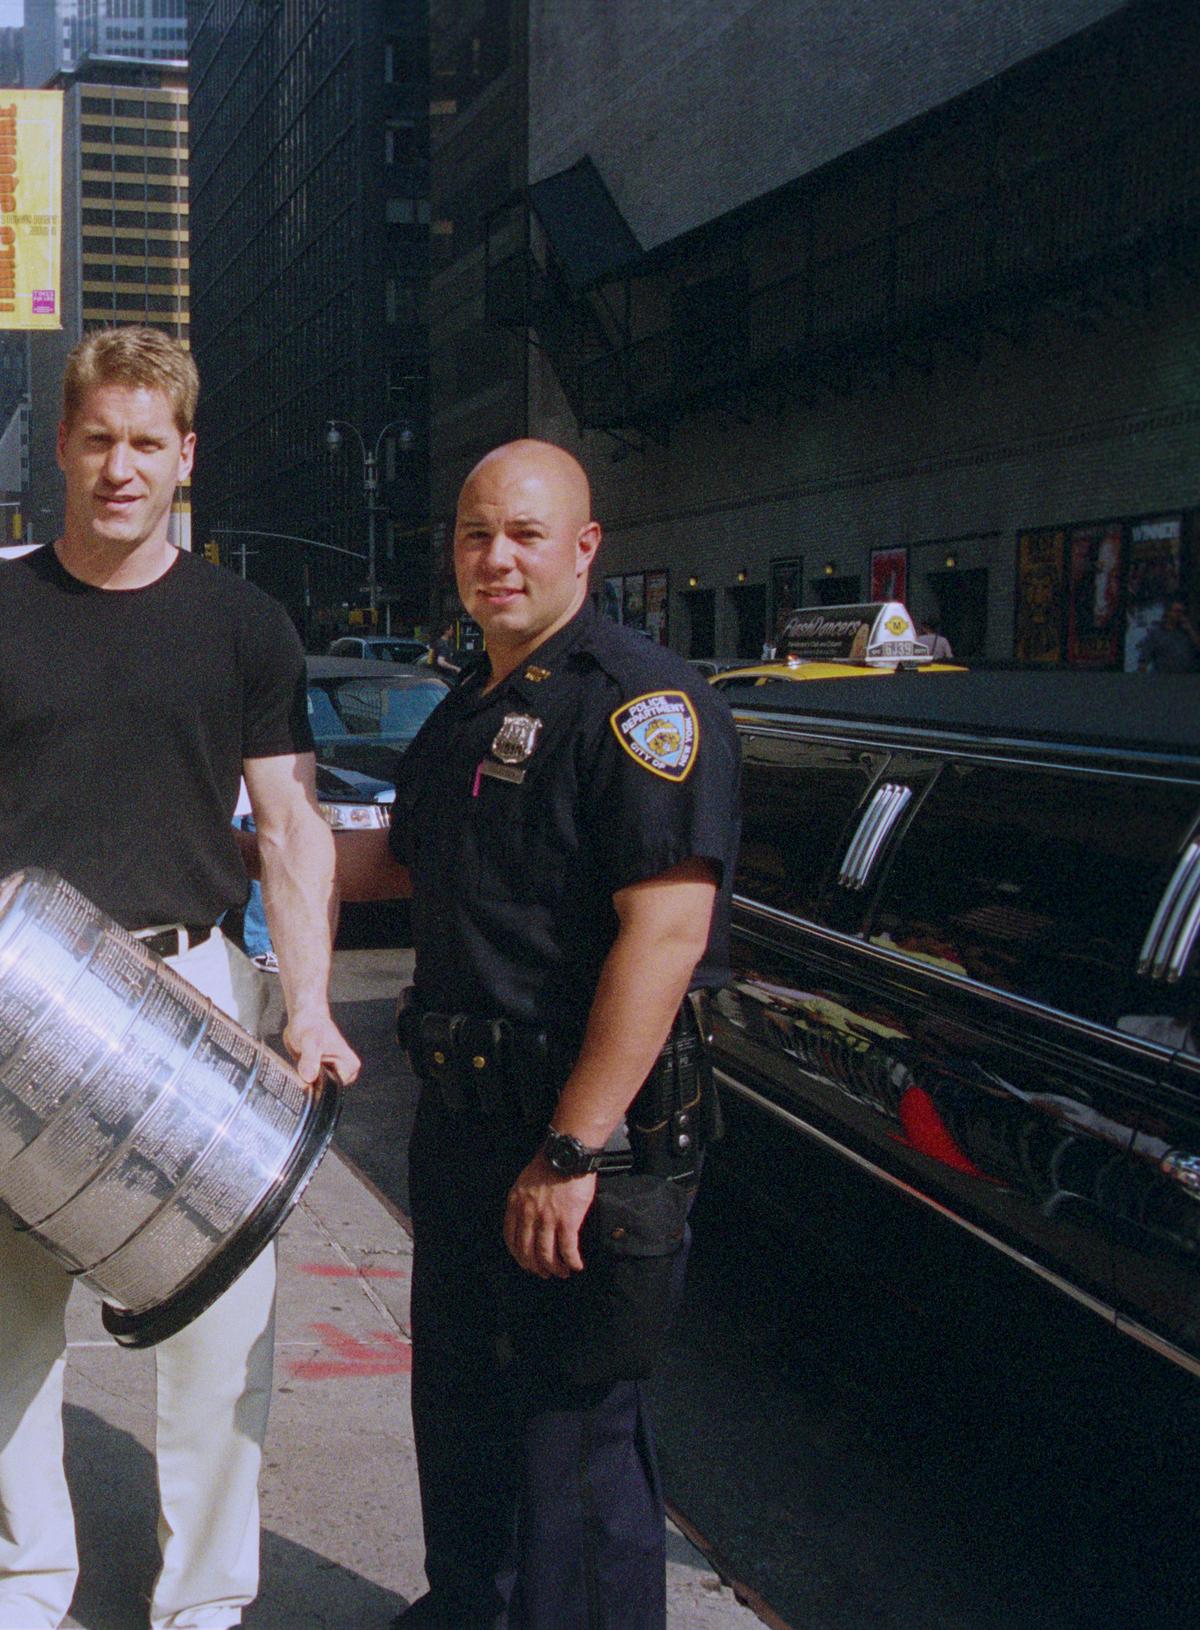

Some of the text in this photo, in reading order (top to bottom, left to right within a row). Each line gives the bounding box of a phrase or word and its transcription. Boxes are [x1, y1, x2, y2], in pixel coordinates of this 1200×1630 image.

[621, 703, 685, 734] DEPARTMENT
[629, 696, 668, 716] POLICE
[630, 742, 652, 761] CITY
[651, 759, 667, 769] OF
